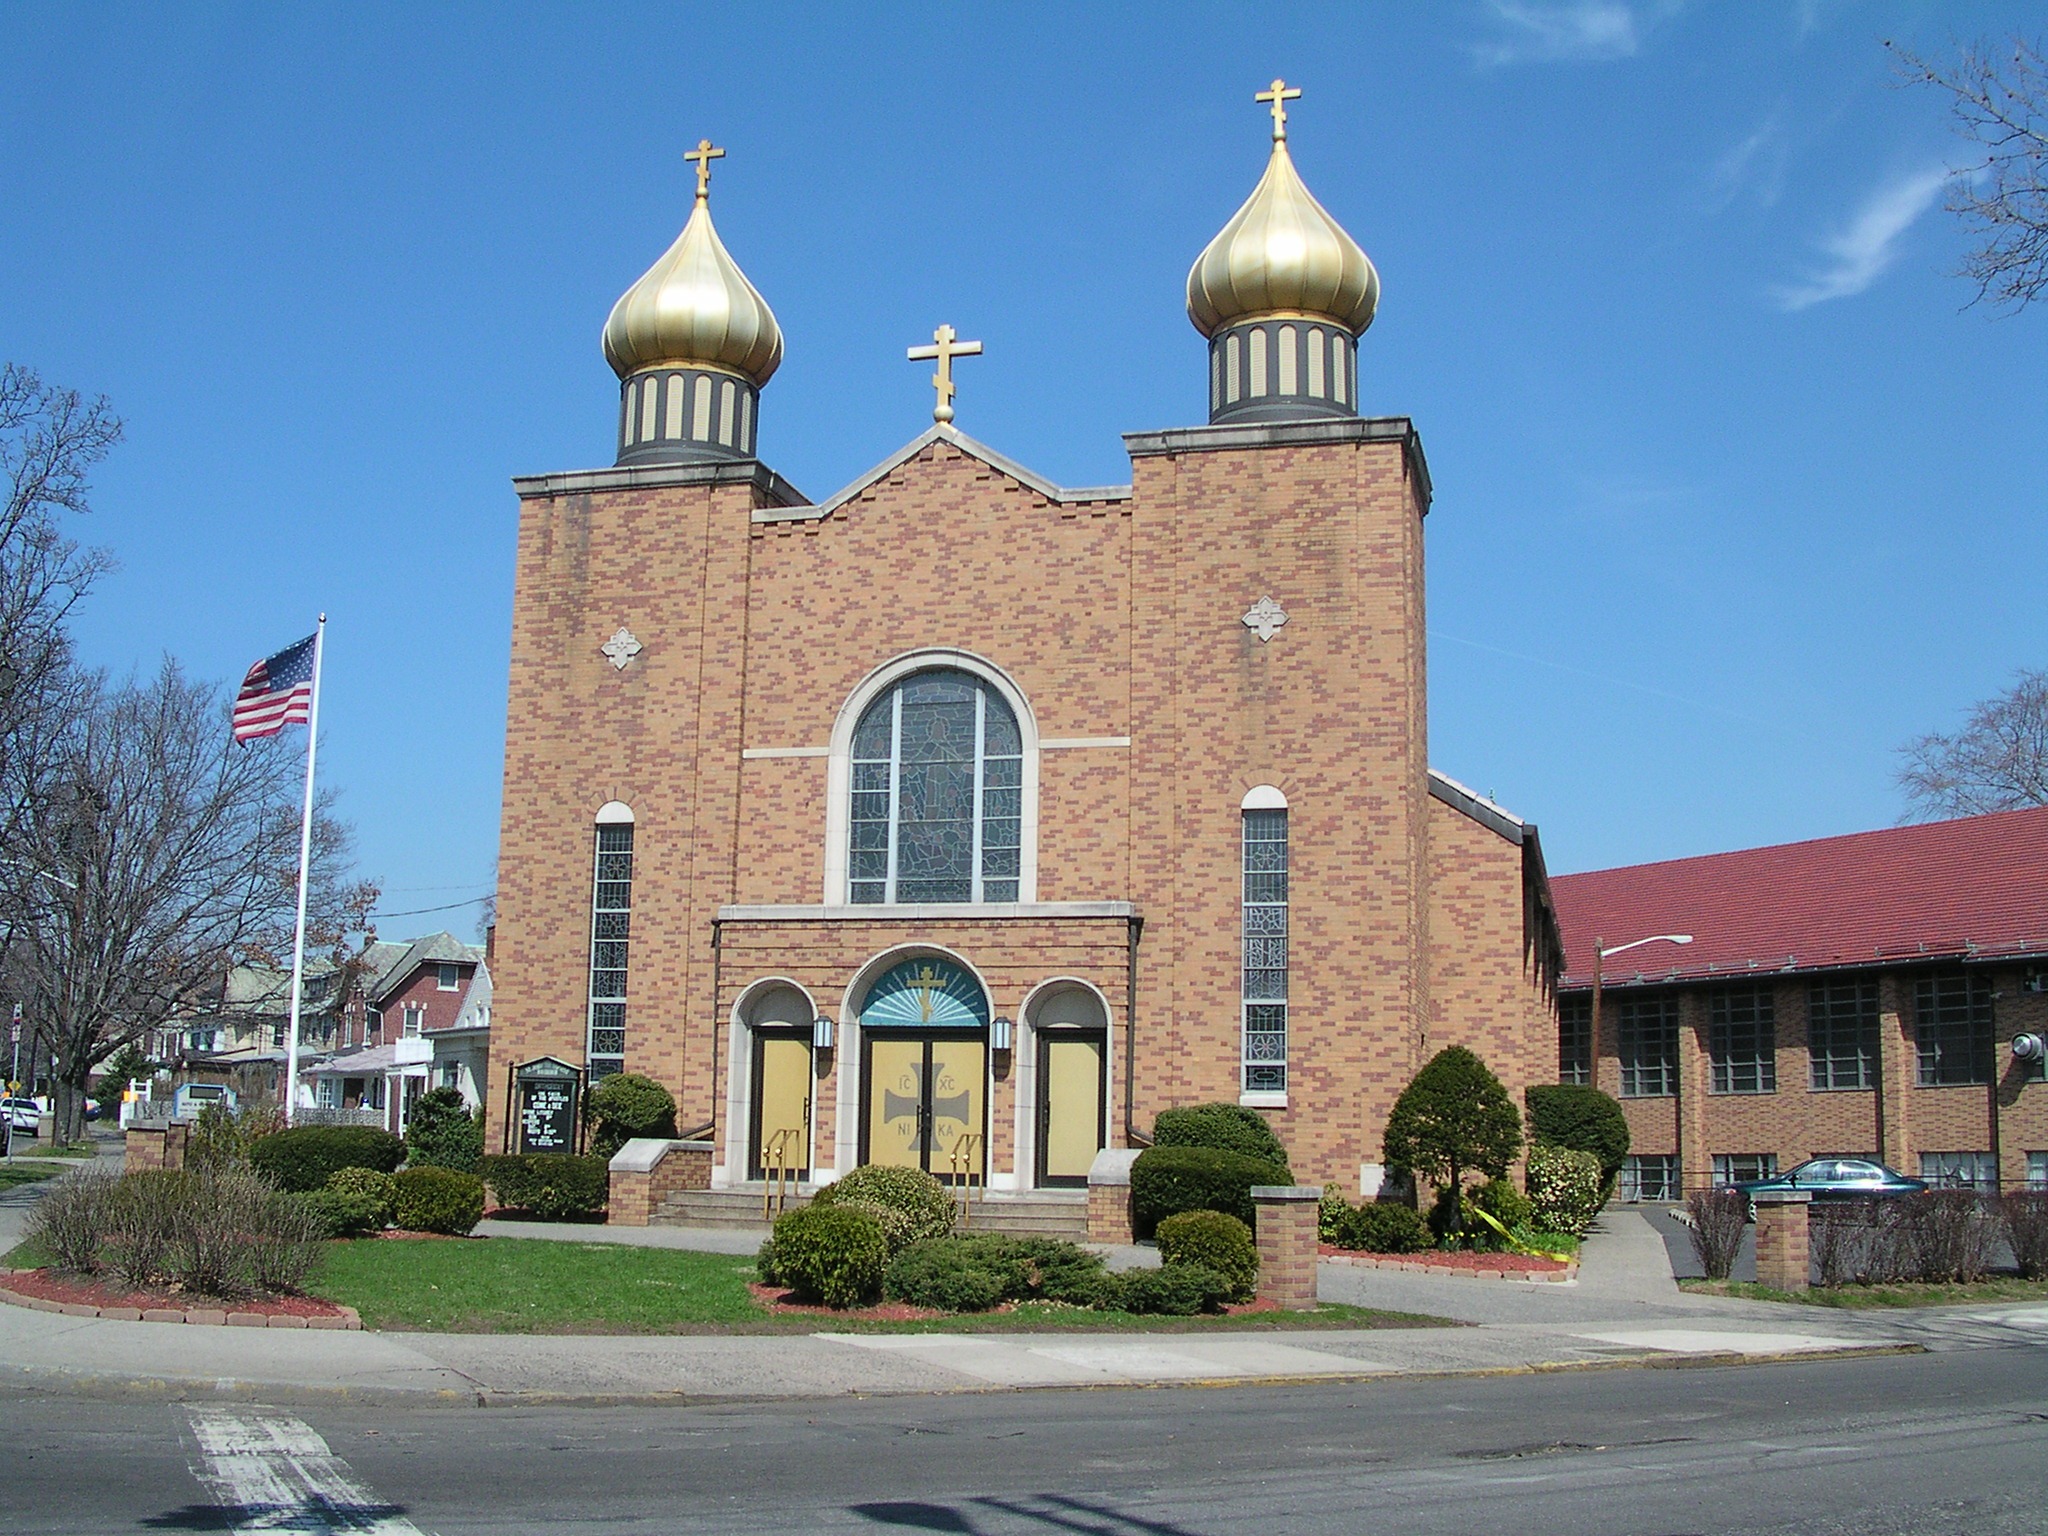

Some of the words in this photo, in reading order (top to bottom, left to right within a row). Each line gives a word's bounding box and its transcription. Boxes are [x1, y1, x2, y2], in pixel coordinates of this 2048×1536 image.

[899, 1076, 911, 1090] IC
[939, 1076, 955, 1091] XC
[898, 1124, 910, 1135] NI
[938, 1125, 953, 1136] KA
